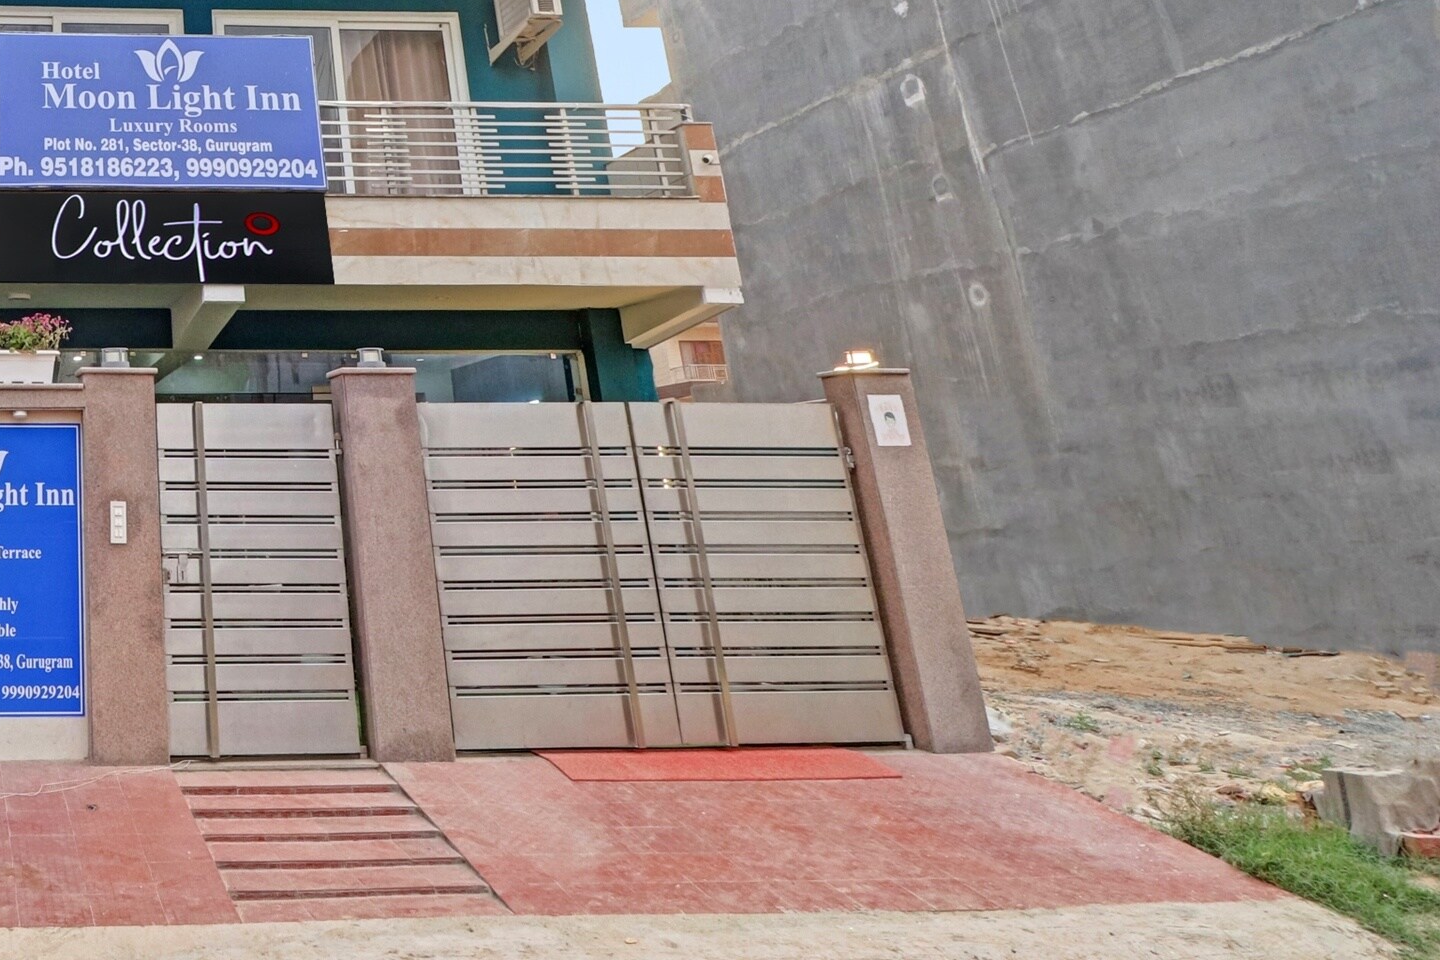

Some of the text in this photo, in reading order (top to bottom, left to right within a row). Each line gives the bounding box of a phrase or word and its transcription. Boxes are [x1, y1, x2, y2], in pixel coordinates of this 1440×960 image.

[41, 62, 99, 80] Hotel
[42, 83, 301, 117] Moon Light Inn
[110, 118, 237, 135] Luxury Rooms
[44, 138, 272, 155] Plot No. 281, Sector-38, Gurugram
[0, 156, 317, 181] Ph. 9518186223, 9990929204
[51, 194, 273, 283] Collection
[35, 482, 75, 506] Inn
[16, 654, 73, 672] Gurugram
[2, 685, 80, 699] 9990929204
